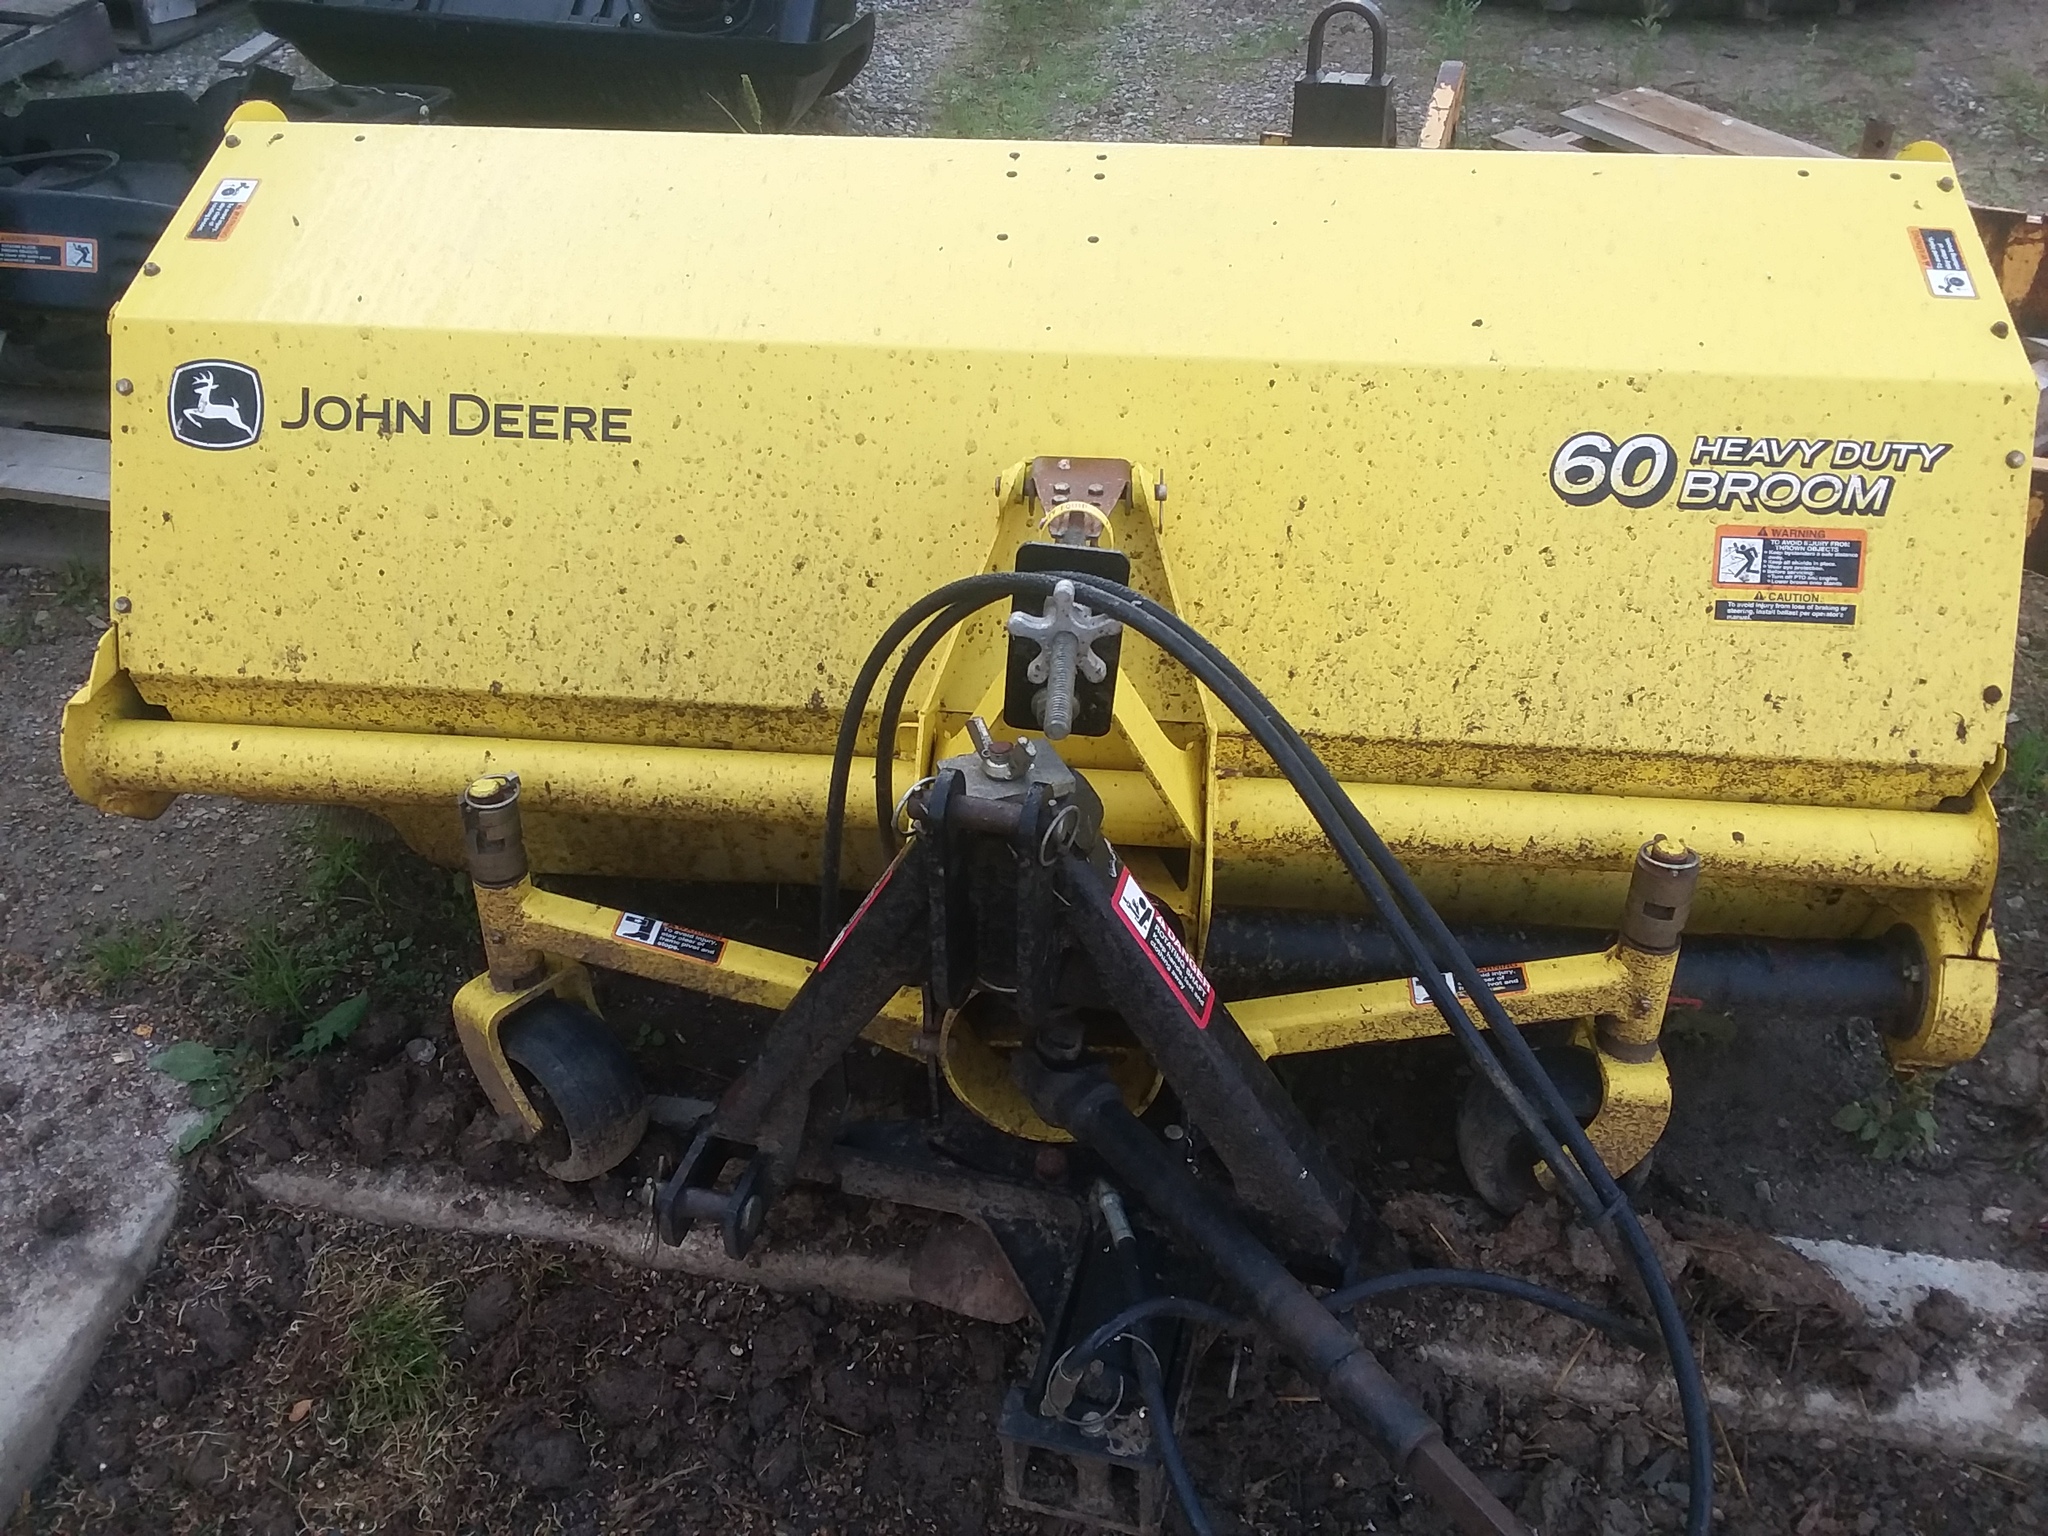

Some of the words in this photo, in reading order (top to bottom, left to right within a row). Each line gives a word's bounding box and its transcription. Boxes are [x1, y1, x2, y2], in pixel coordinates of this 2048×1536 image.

[281, 387, 431, 435] JOHN
[449, 393, 632, 443] DEERE
[1549, 431, 1678, 508] 60
[1690, 435, 1832, 469] HEAVY
[1830, 440, 1953, 472] DUTY
[1677, 469, 1895, 517] BROOM
[1771, 528, 1826, 539] WARNING
[1768, 592, 1820, 603] CAUTION
[1150, 940, 1171, 971] clothing
[1152, 932, 1167, 953] Keep
[1166, 950, 1185, 979] hands,
[1154, 923, 1186, 967] ROTATING
[1185, 967, 1207, 998] SHAFT
[1166, 925, 1211, 993] DANGER
